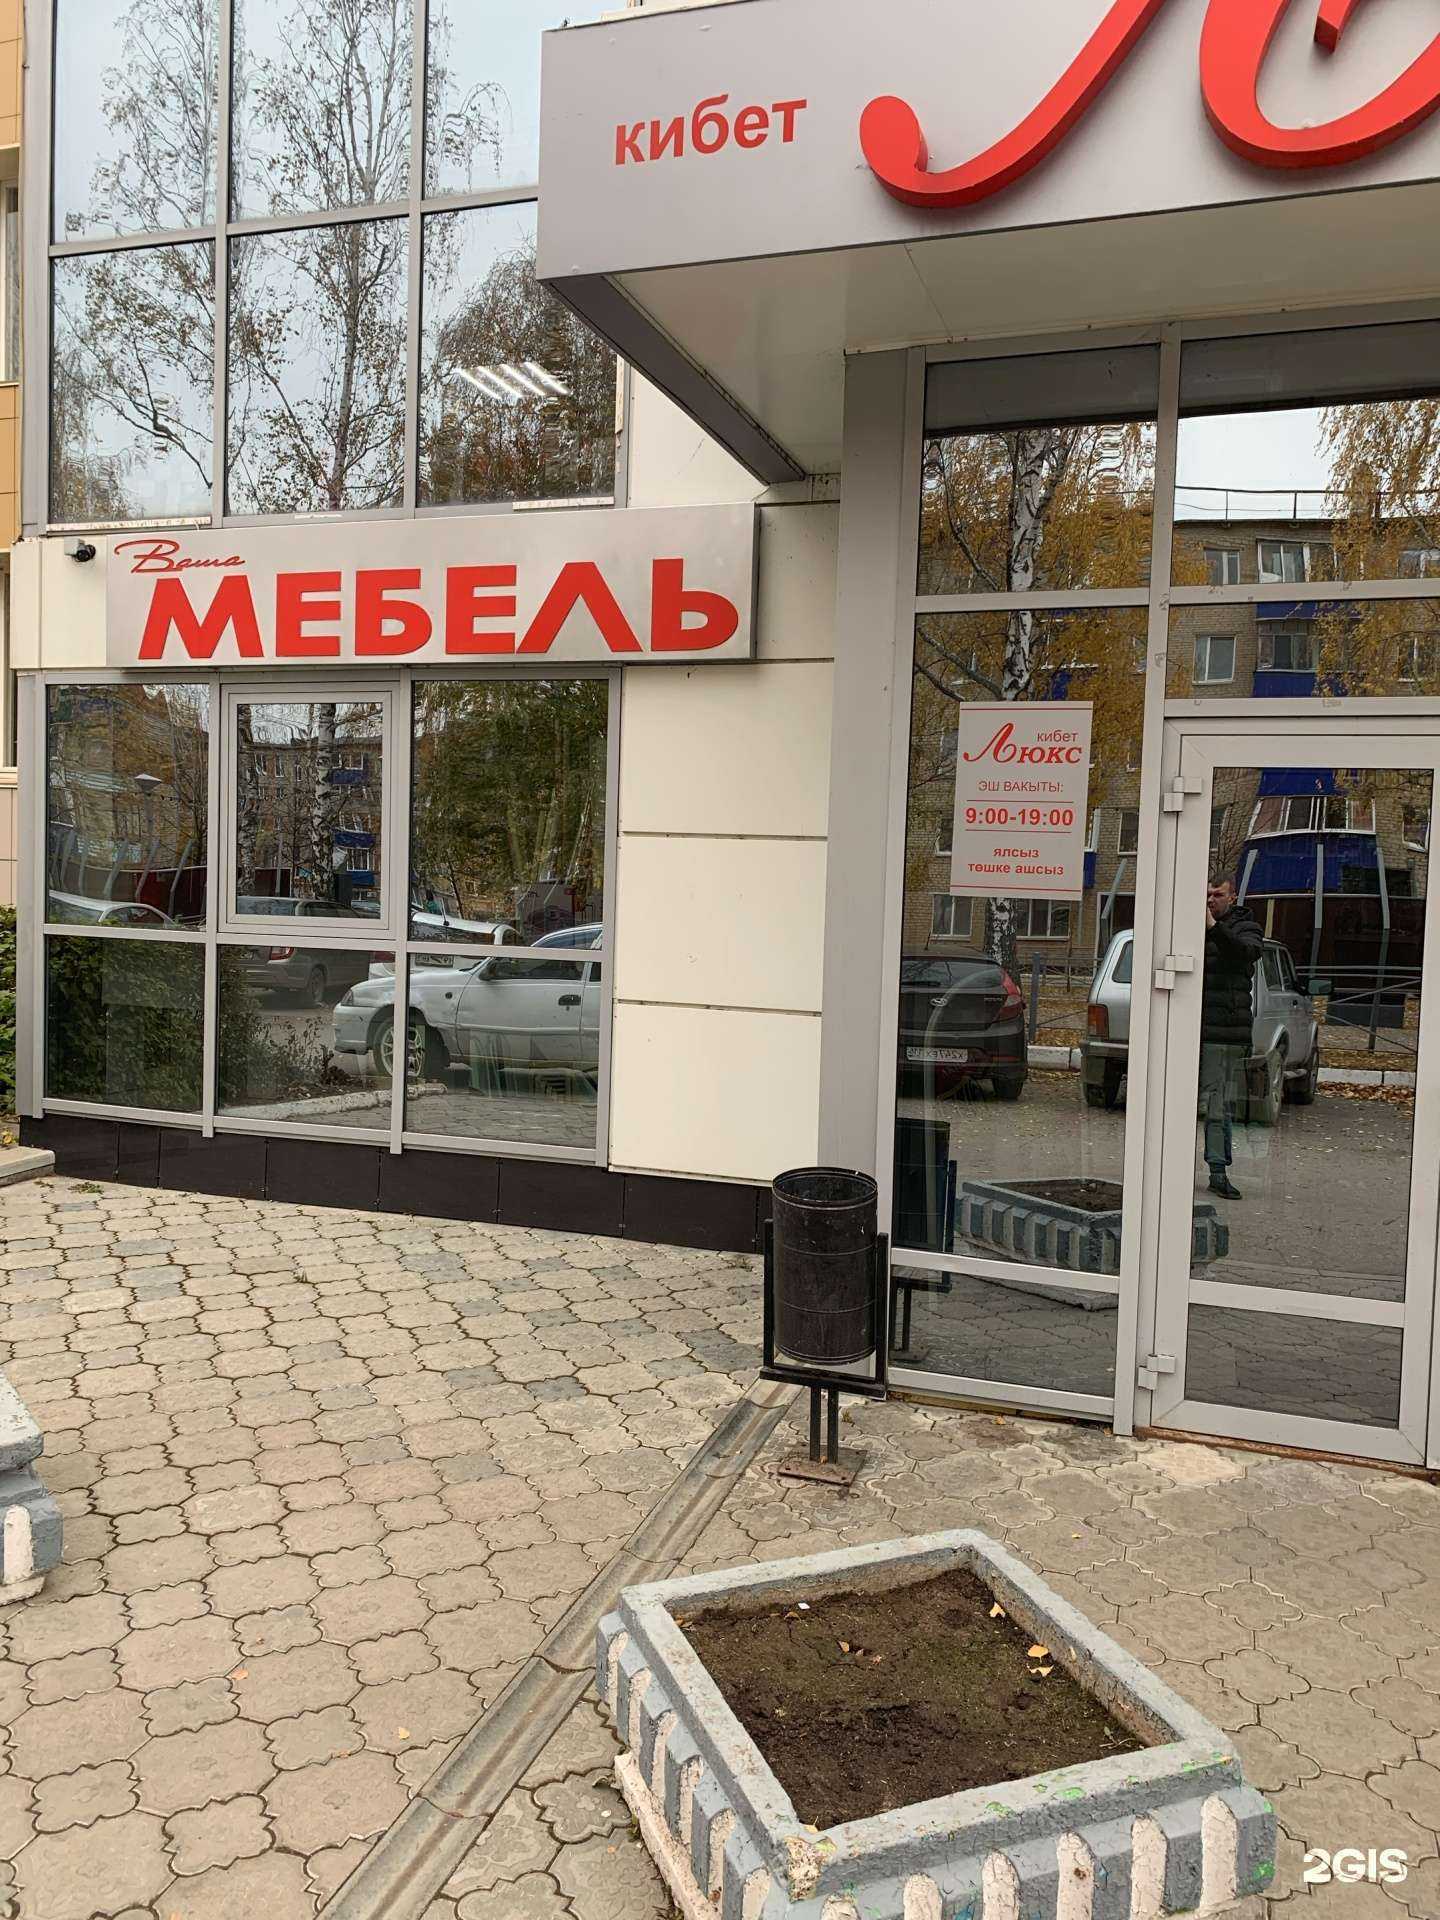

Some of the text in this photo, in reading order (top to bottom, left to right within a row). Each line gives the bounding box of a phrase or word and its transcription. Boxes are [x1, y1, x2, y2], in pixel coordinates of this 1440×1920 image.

[616, 94, 807, 166] кибет
[115, 538, 246, 574] Ваша
[138, 557, 740, 661] МЕБЕЛЬ
[962, 722, 1083, 764] Люкс
[1037, 729, 1078, 743] кибет
[978, 780, 1064, 793] ЭШ ВАКЫТЫ:
[965, 807, 1074, 826] 9:00-19:00
[993, 847, 1039, 859] ялсыз
[967, 862, 1064, 876] төшке ашсыз
